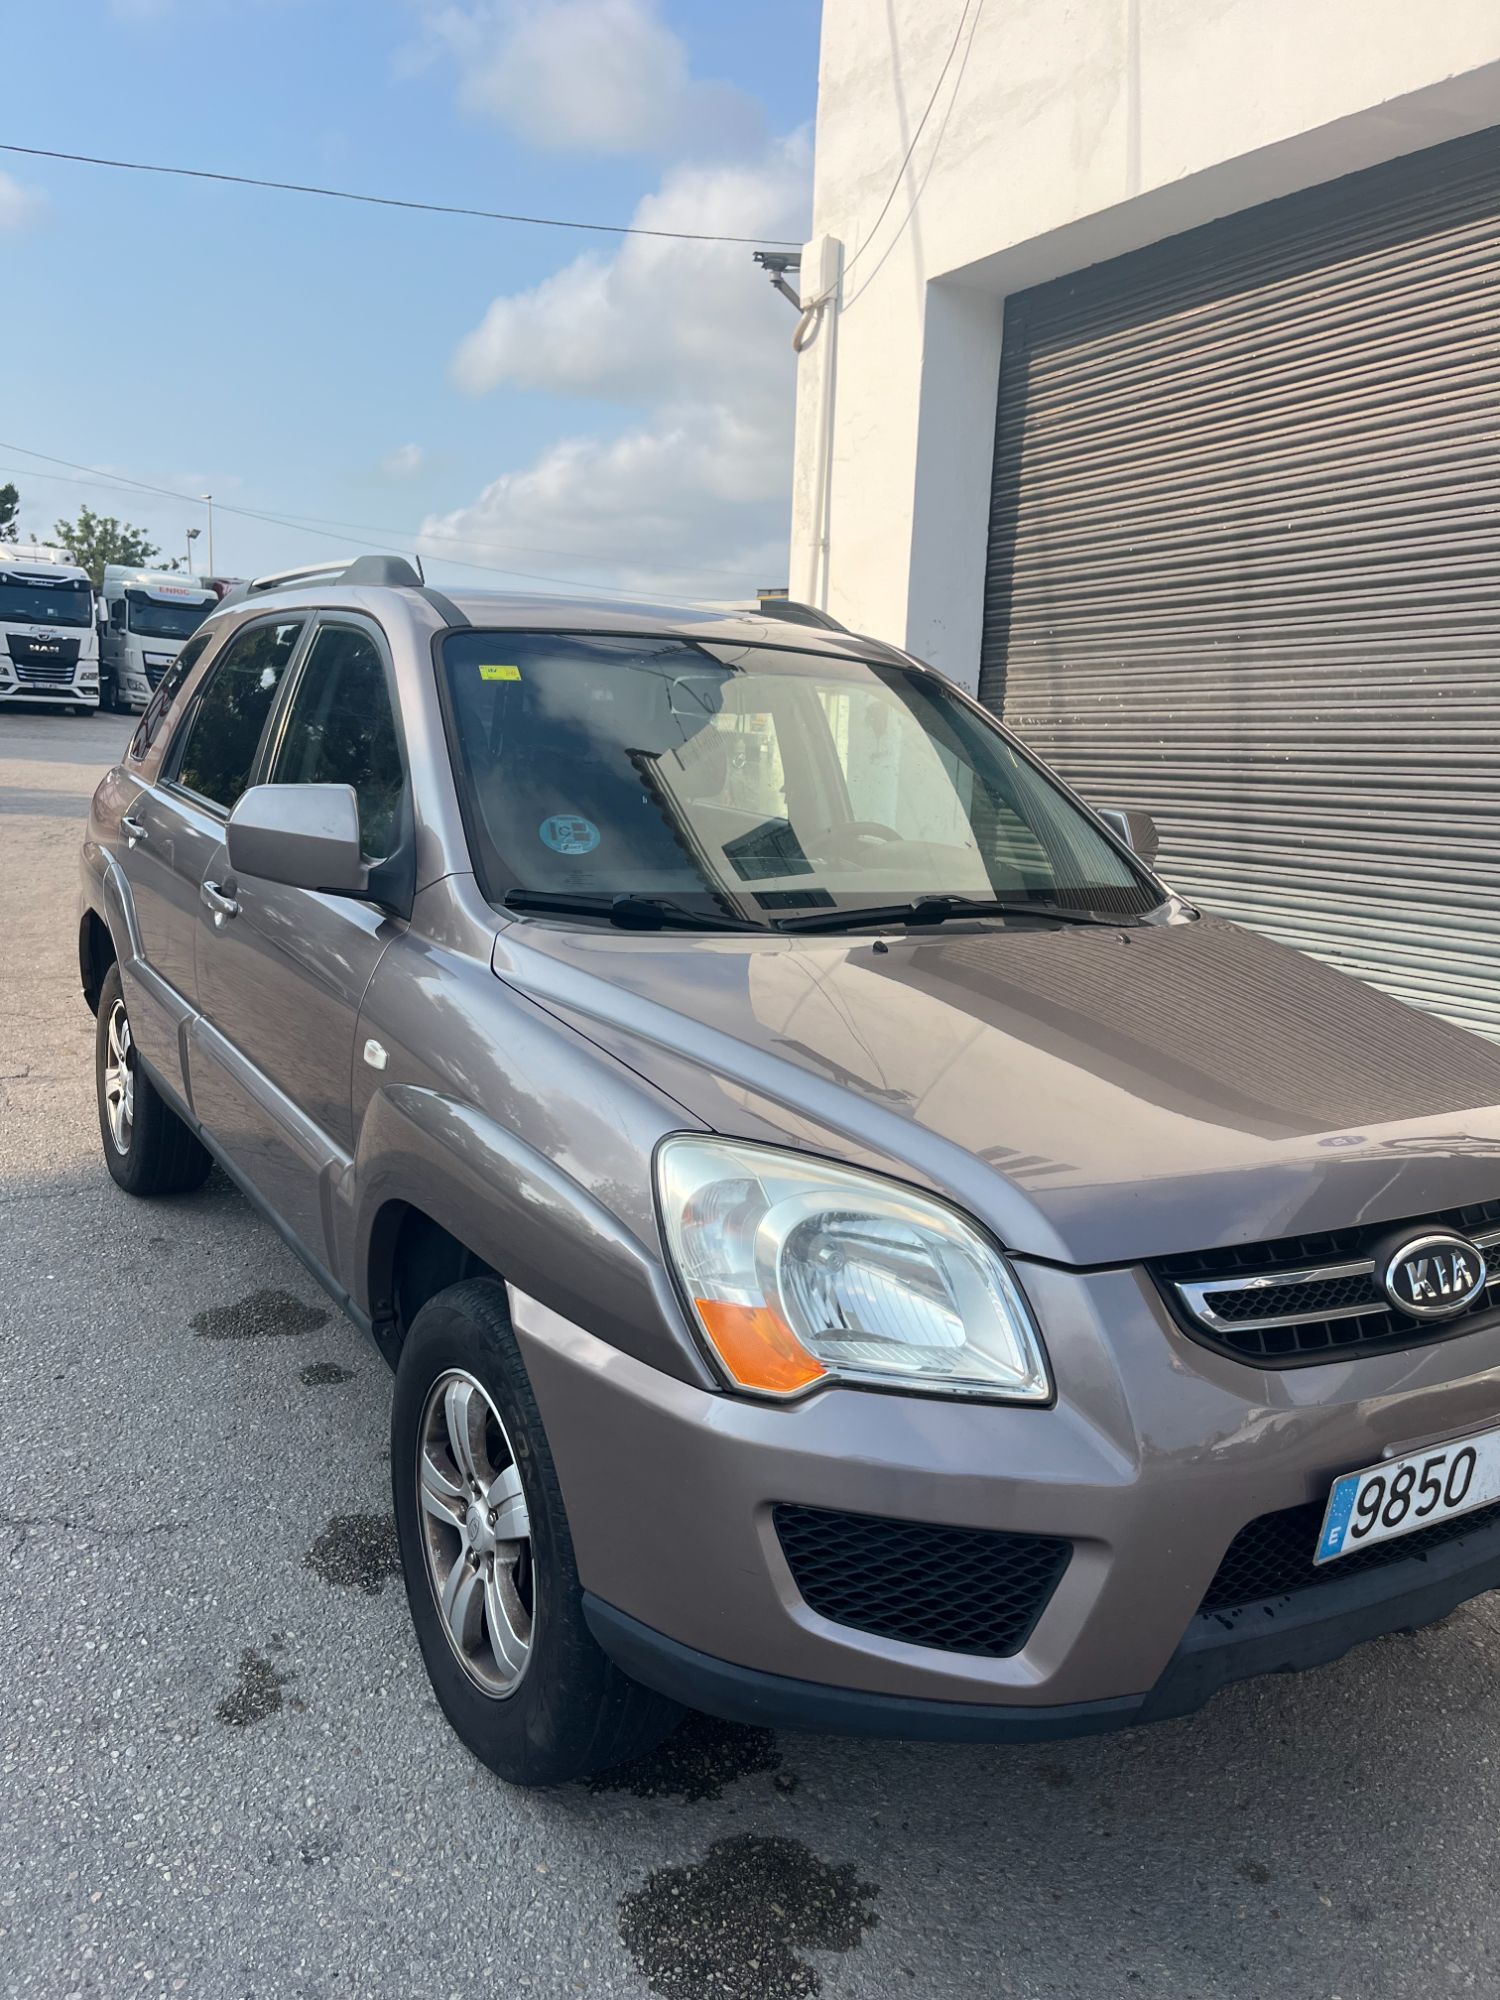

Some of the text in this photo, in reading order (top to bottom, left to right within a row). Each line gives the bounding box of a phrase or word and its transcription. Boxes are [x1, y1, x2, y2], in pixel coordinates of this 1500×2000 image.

[29, 644, 60, 653] MAN
[1404, 1249, 1474, 1300] KIA
[1328, 1446, 1477, 1545] E 9850
